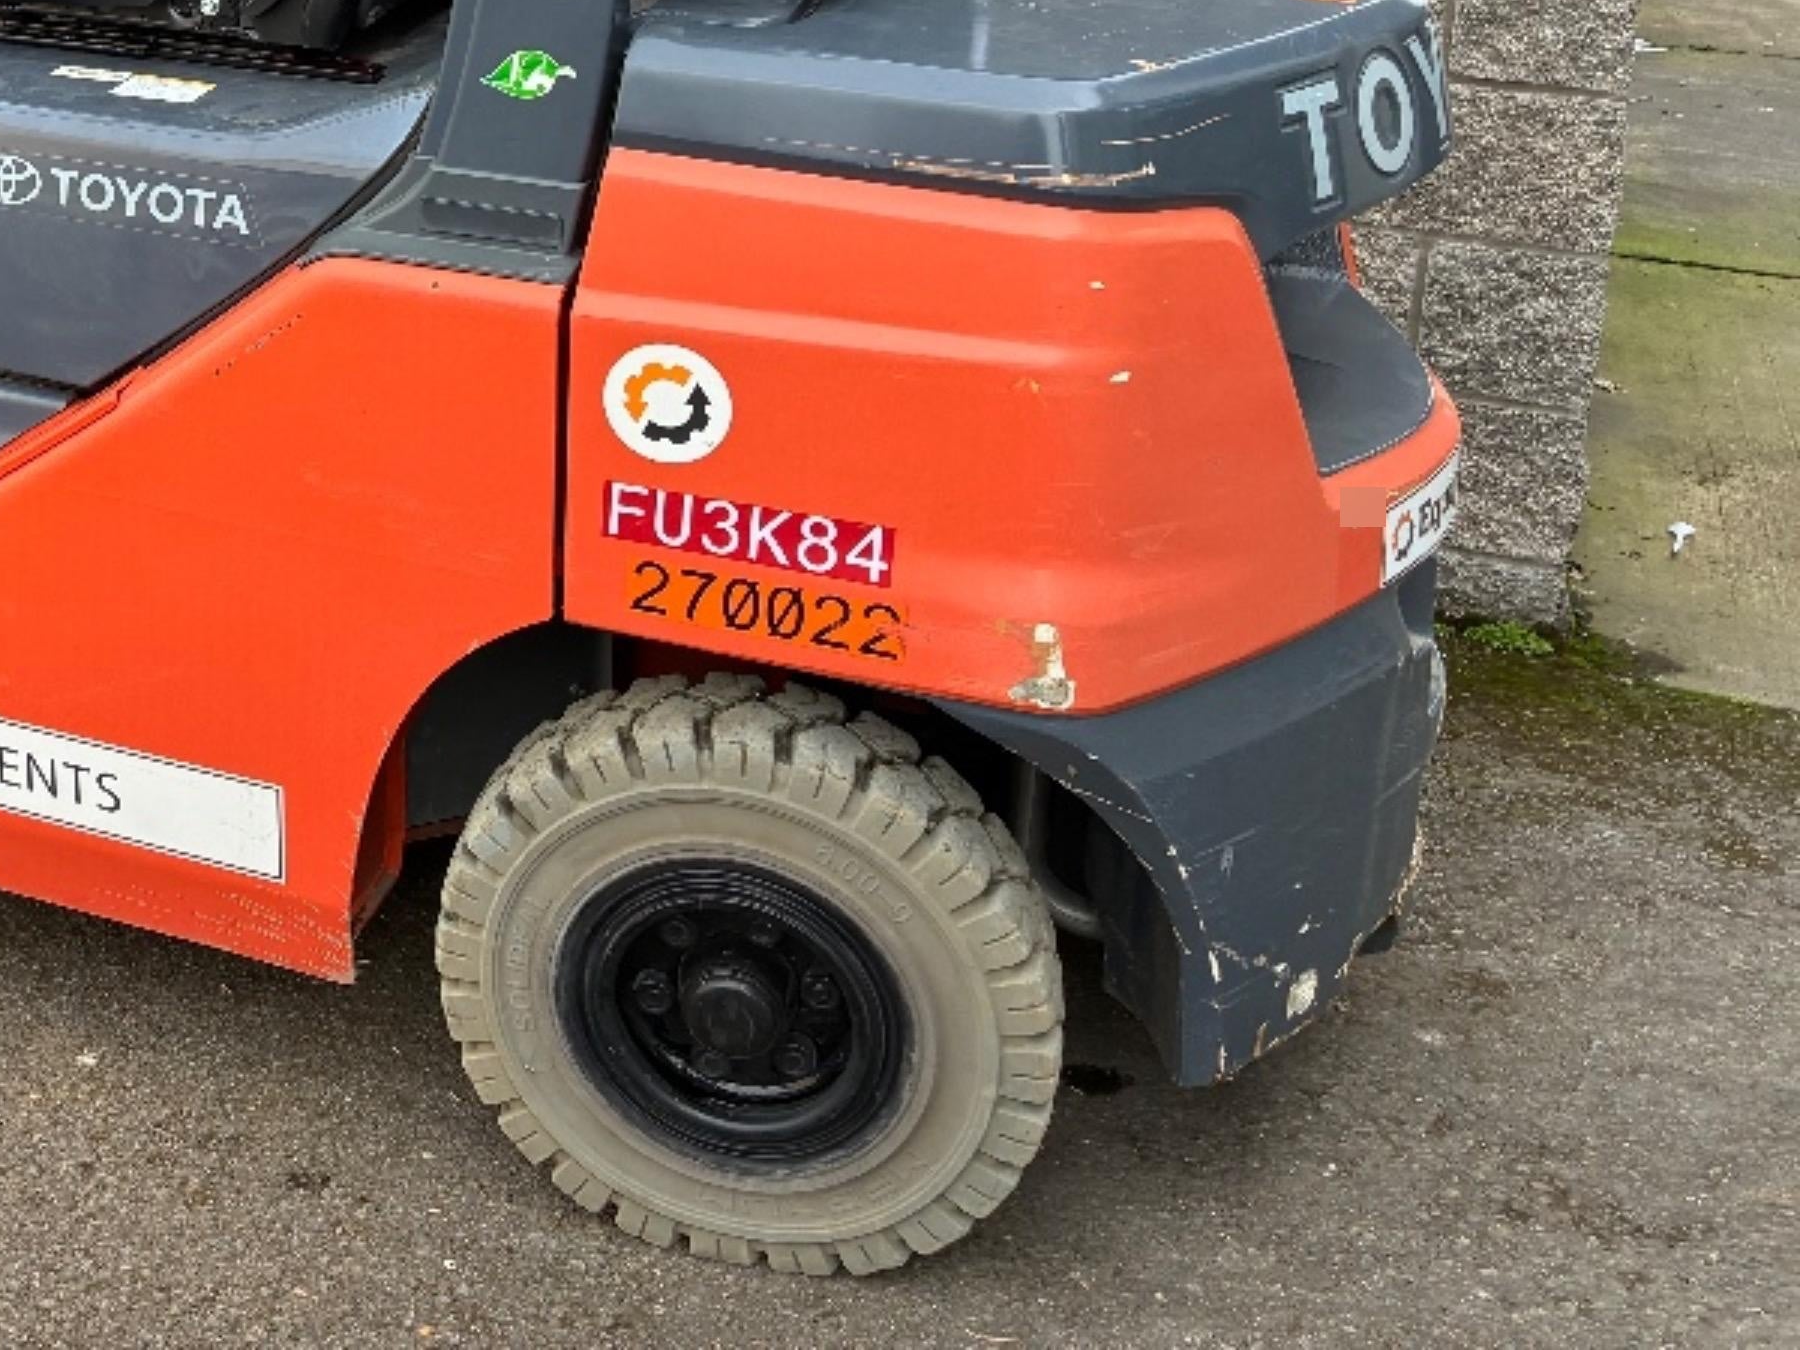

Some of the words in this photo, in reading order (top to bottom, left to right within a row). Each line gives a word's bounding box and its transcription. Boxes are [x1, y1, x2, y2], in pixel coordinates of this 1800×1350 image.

[50, 167, 250, 235] TOYOTA
[607, 481, 890, 584] FU3K84
[629, 560, 902, 661] 270022
